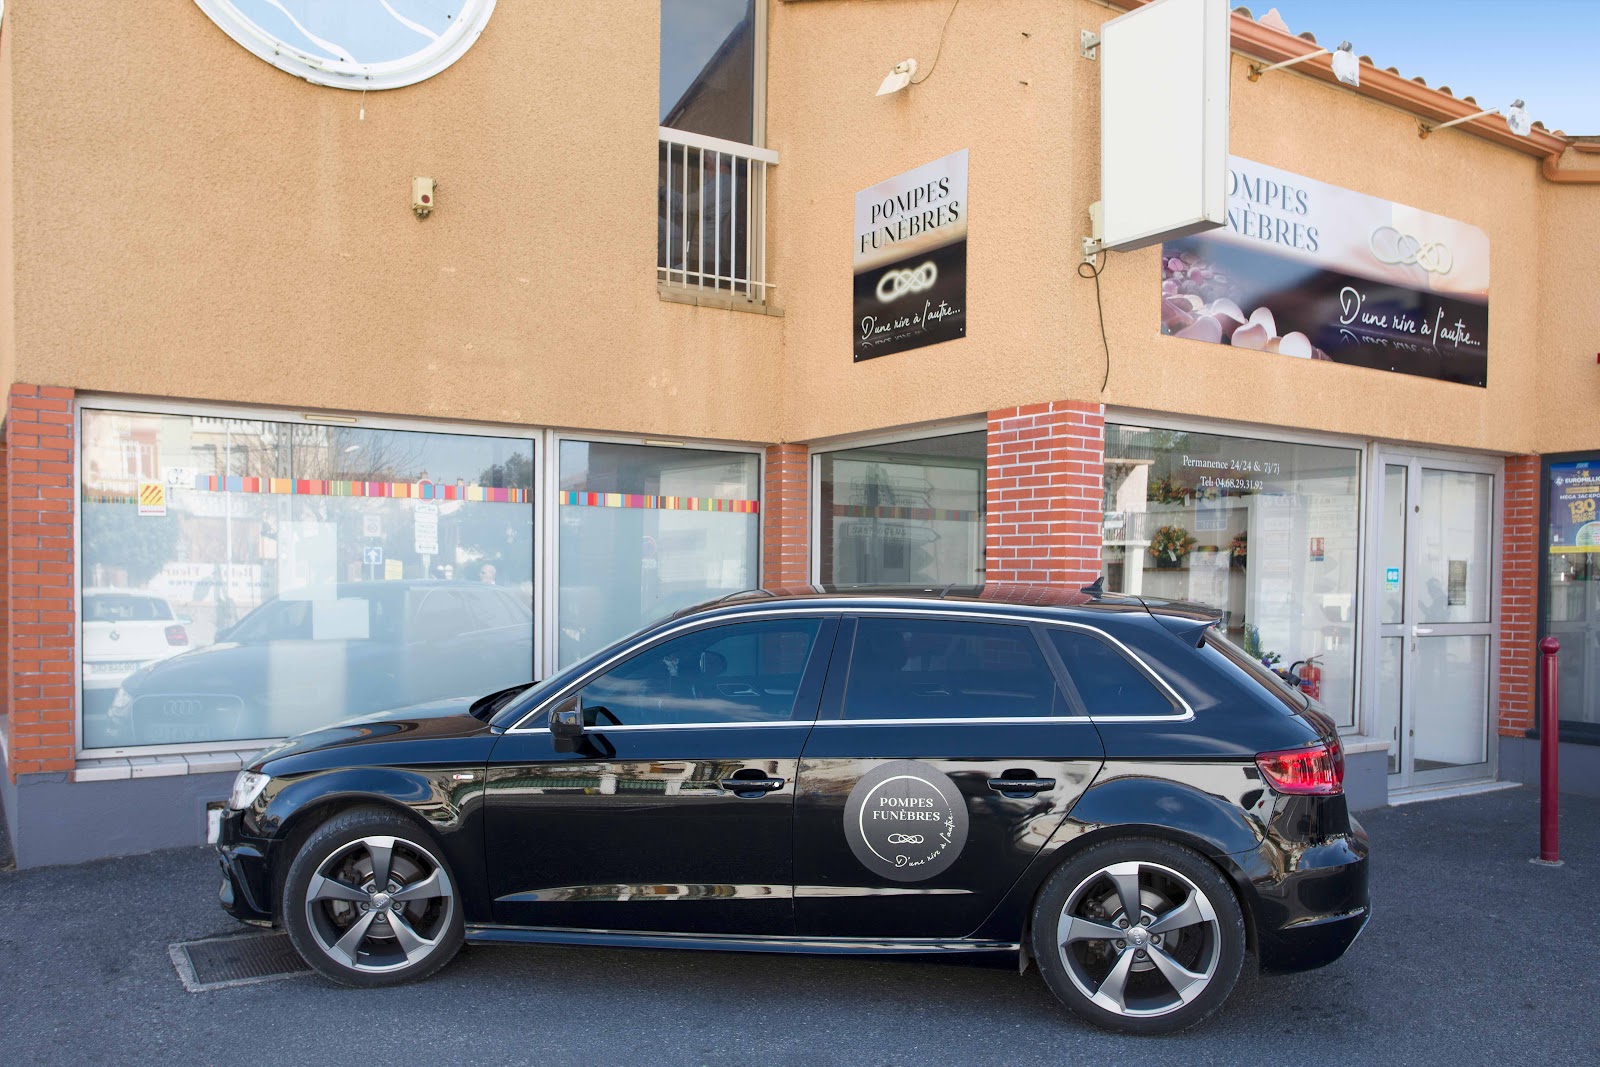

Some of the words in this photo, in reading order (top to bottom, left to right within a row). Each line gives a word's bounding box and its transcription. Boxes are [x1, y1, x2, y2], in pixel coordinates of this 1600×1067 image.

[871, 176, 950, 225] POMPES
[1228, 169, 1308, 216] OMPES
[861, 200, 960, 254] FUNÈBRES
[1228, 203, 1318, 252] NÈBRES
[862, 316, 891, 340] D'une
[894, 317, 910, 329] rive
[914, 312, 921, 324] à
[921, 300, 961, 329] l'autre...
[1340, 286, 1388, 328] D'une
[1392, 314, 1416, 333] rive
[1420, 319, 1432, 335] à
[1432, 306, 1481, 348] l'autre...
[1182, 455, 1229, 470] Permanence
[1230, 459, 1252, 472] 24/24
[1253, 461, 1262, 472] &
[1264, 462, 1280, 475] 7j/7j
[1215, 477, 1263, 490] 04.68.29.31.92
[1568, 499, 1596, 514] 130
[873, 808, 940, 821] FUNÈBRES
[880, 797, 934, 808] POMPES
[895, 854, 925, 868] D'une
[927, 850, 940, 861] rive
